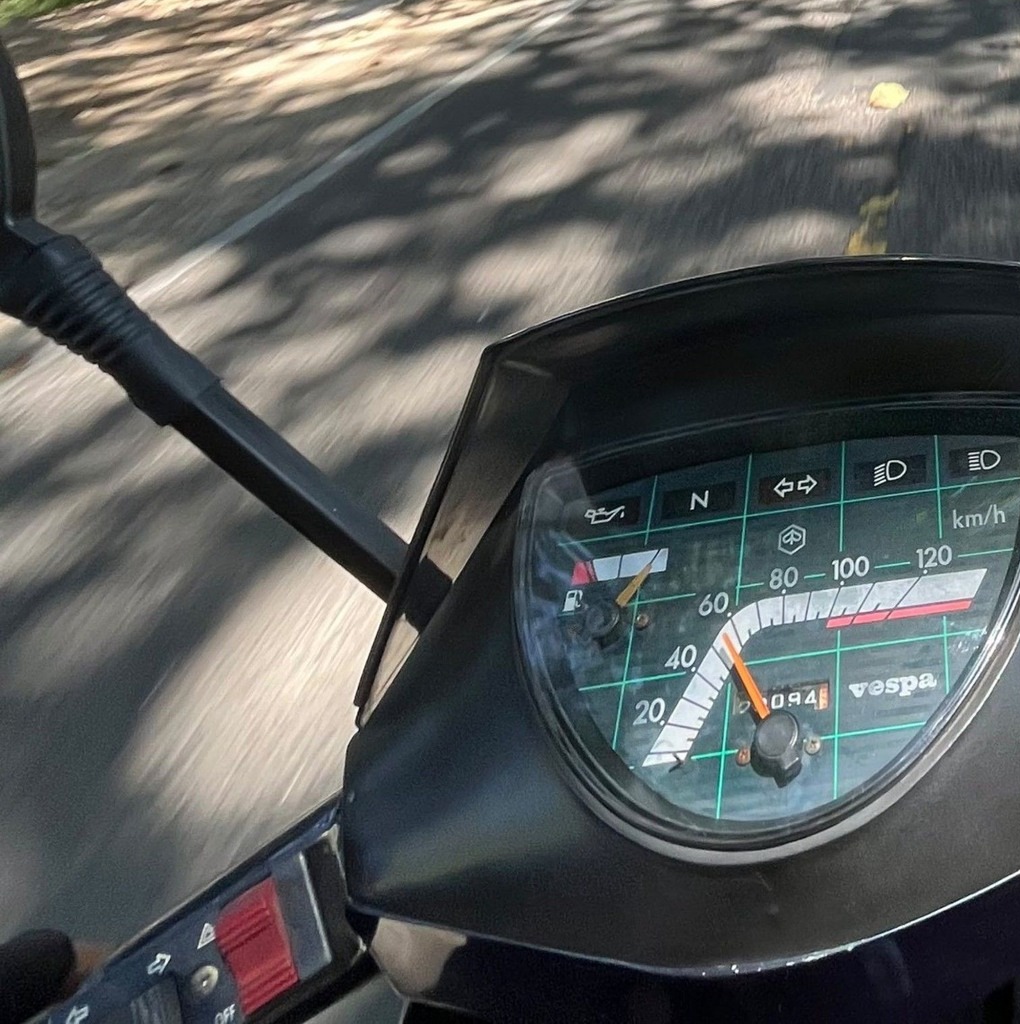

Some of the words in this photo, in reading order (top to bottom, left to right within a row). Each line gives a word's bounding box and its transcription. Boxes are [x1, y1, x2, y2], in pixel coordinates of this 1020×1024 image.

[689, 490, 710, 511] N
[952, 504, 1006, 529] km/h
[831, 555, 870, 581] 100
[915, 544, 953, 569] 120
[769, 566, 799, 590] 80
[698, 591, 729, 617] 60
[664, 644, 697, 670] 40
[848, 673, 938, 698] vespa
[632, 697, 666, 726] 20
[214, 1003, 236, 1024] OFF
